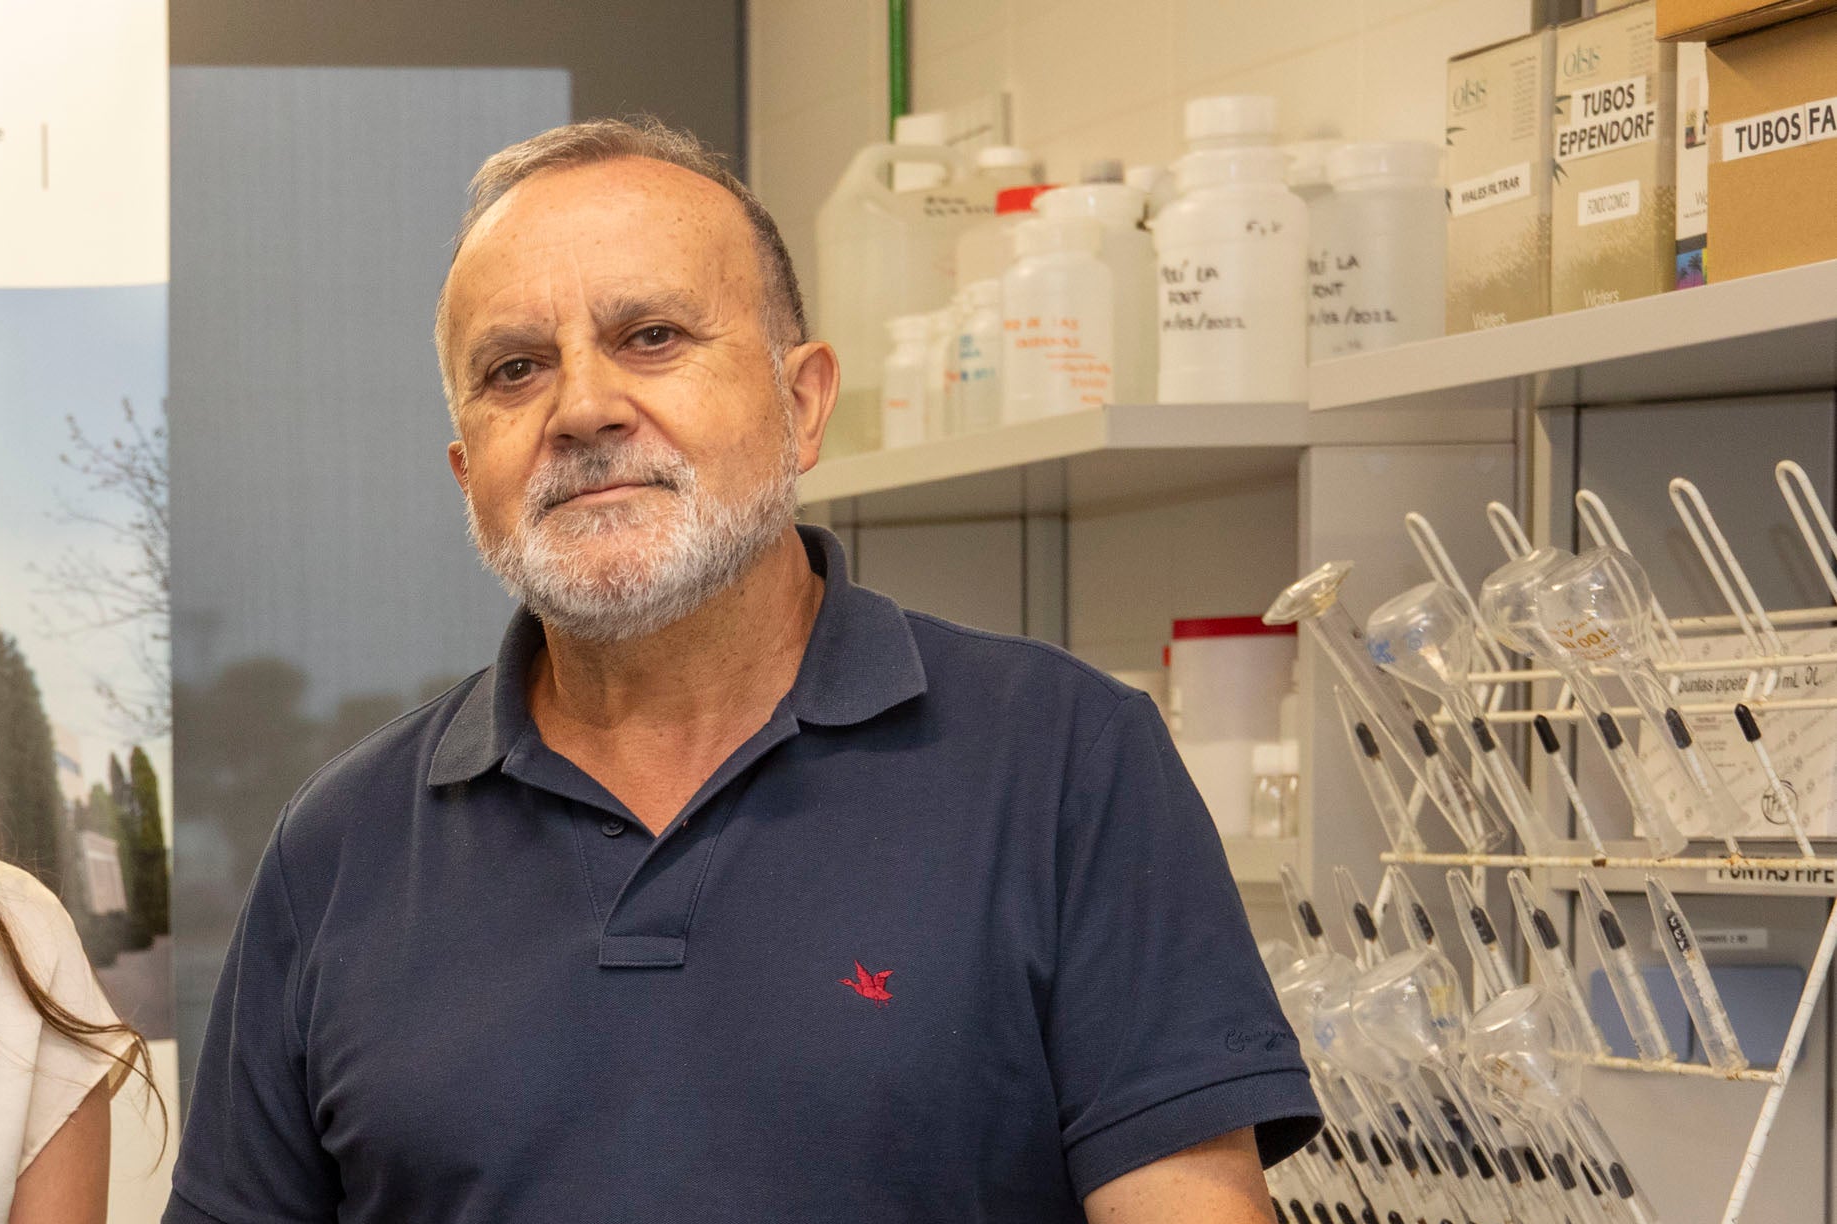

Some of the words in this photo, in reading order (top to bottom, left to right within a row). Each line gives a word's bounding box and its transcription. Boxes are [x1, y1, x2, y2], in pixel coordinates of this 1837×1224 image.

[1582, 83, 1635, 118] TUBOS
[1559, 111, 1655, 157] EPPENDORF
[1735, 113, 1801, 153] TUBOS
